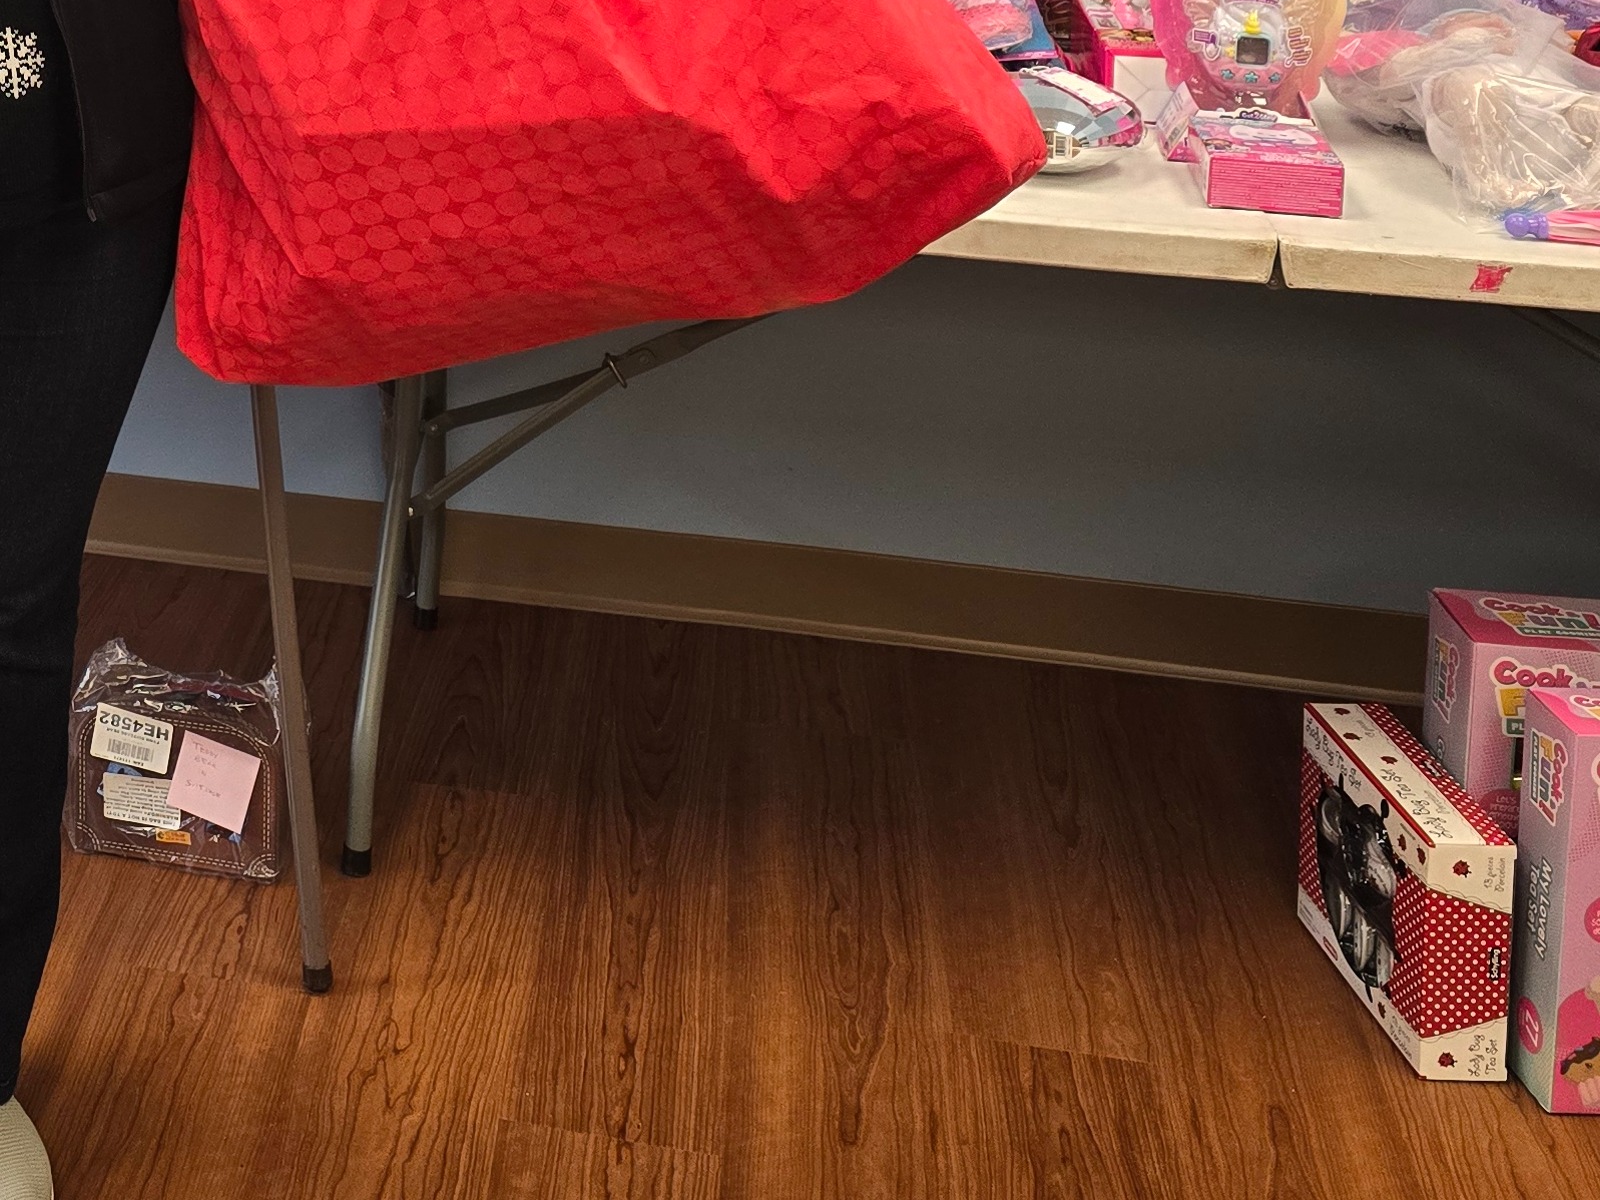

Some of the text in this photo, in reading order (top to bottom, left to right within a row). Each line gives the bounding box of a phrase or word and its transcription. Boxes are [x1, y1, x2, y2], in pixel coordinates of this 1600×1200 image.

[1483, 599, 1562, 616] Cook
[1493, 660, 1573, 688] Cook
[99, 710, 170, 741] HE4582
[1511, 722, 1525, 731] PL
[1550, 742, 1568, 803] Cook
[1526, 861, 1540, 936] Tea Set
[1534, 856, 1553, 960] My Lovely
[1525, 1010, 1539, 1048] 27
